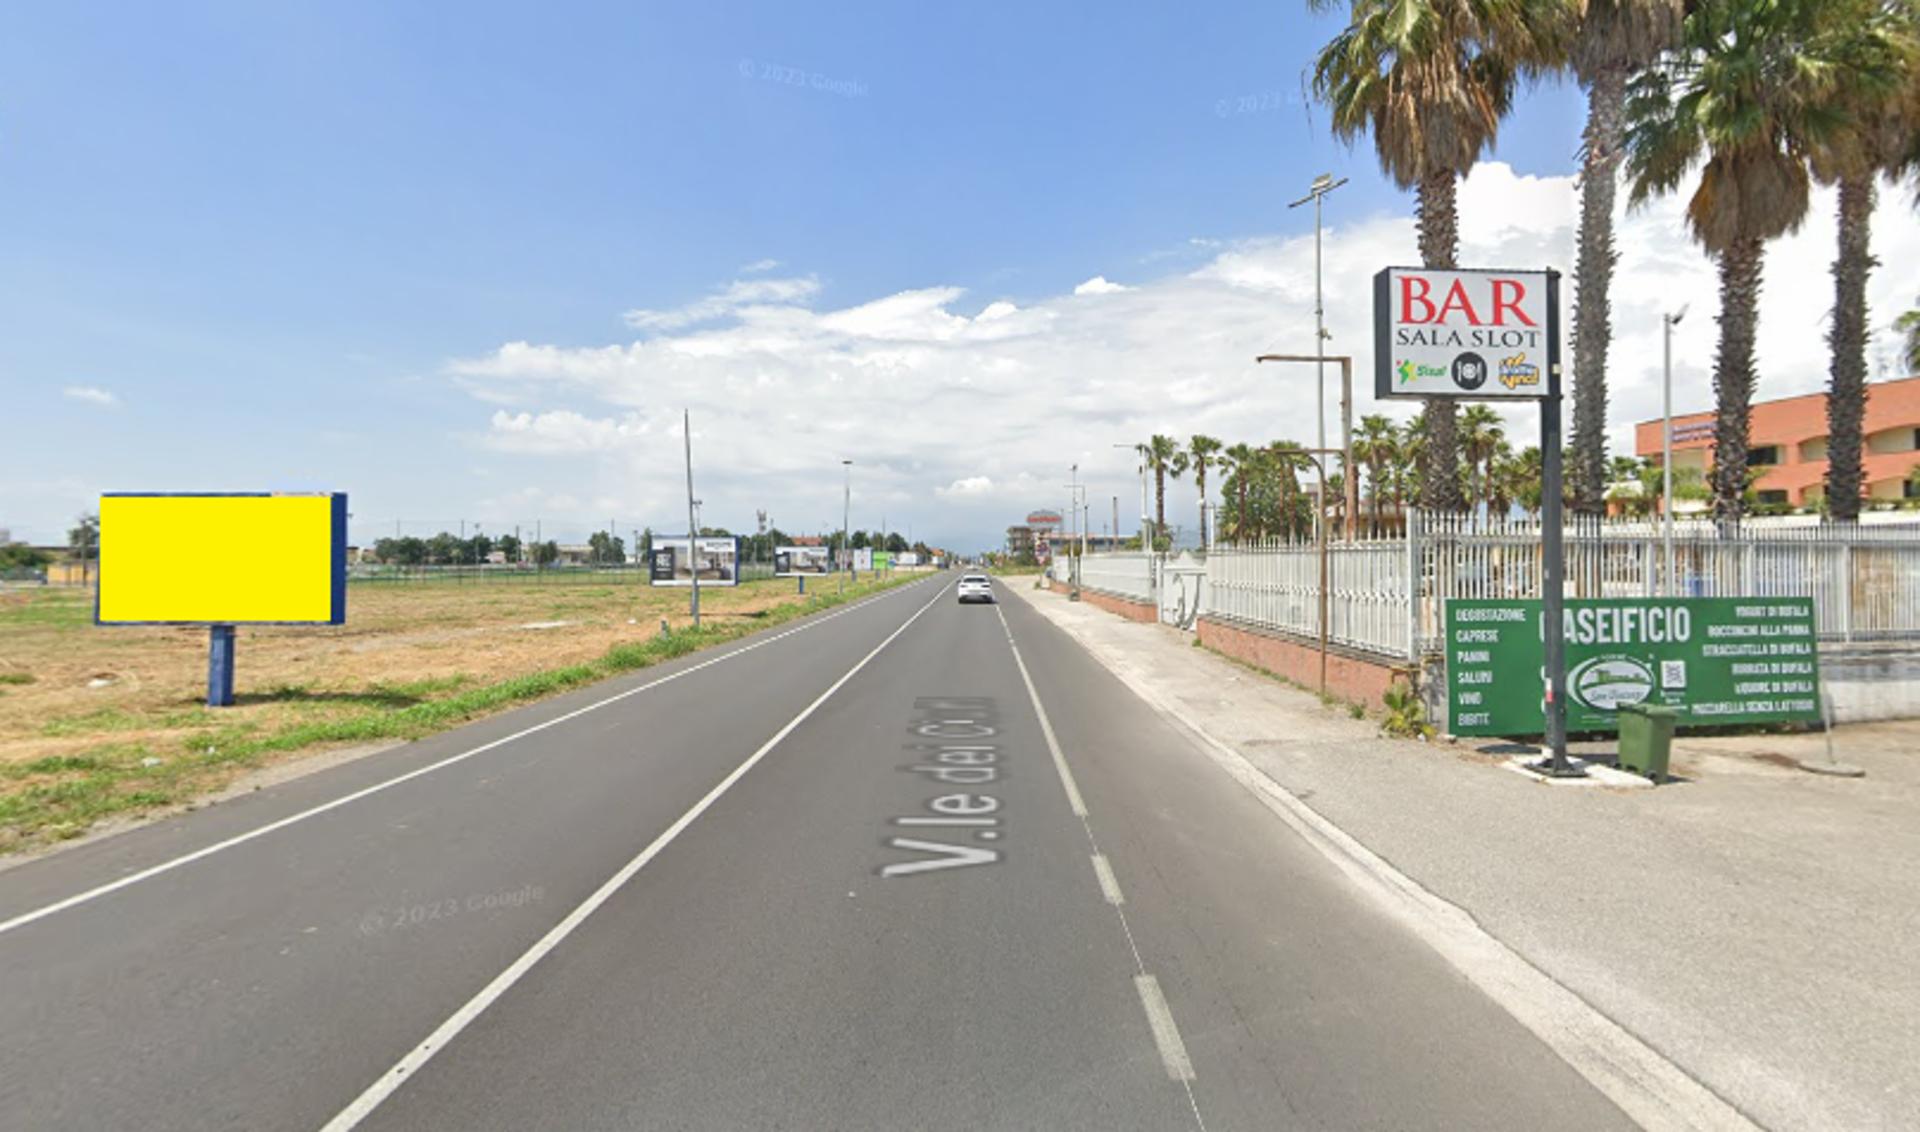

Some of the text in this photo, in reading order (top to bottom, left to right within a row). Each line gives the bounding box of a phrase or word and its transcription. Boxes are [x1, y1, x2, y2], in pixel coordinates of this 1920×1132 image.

[1396, 276, 1539, 327] BAR
[1396, 329, 1541, 348] SALA SLOT
[1455, 607, 1527, 622] DEGUSTAZIONE
[1455, 629, 1499, 643] CAPRESE
[1456, 650, 1491, 664] PANINI
[1457, 670, 1493, 684] SALUMI
[1458, 691, 1482, 705] VINO
